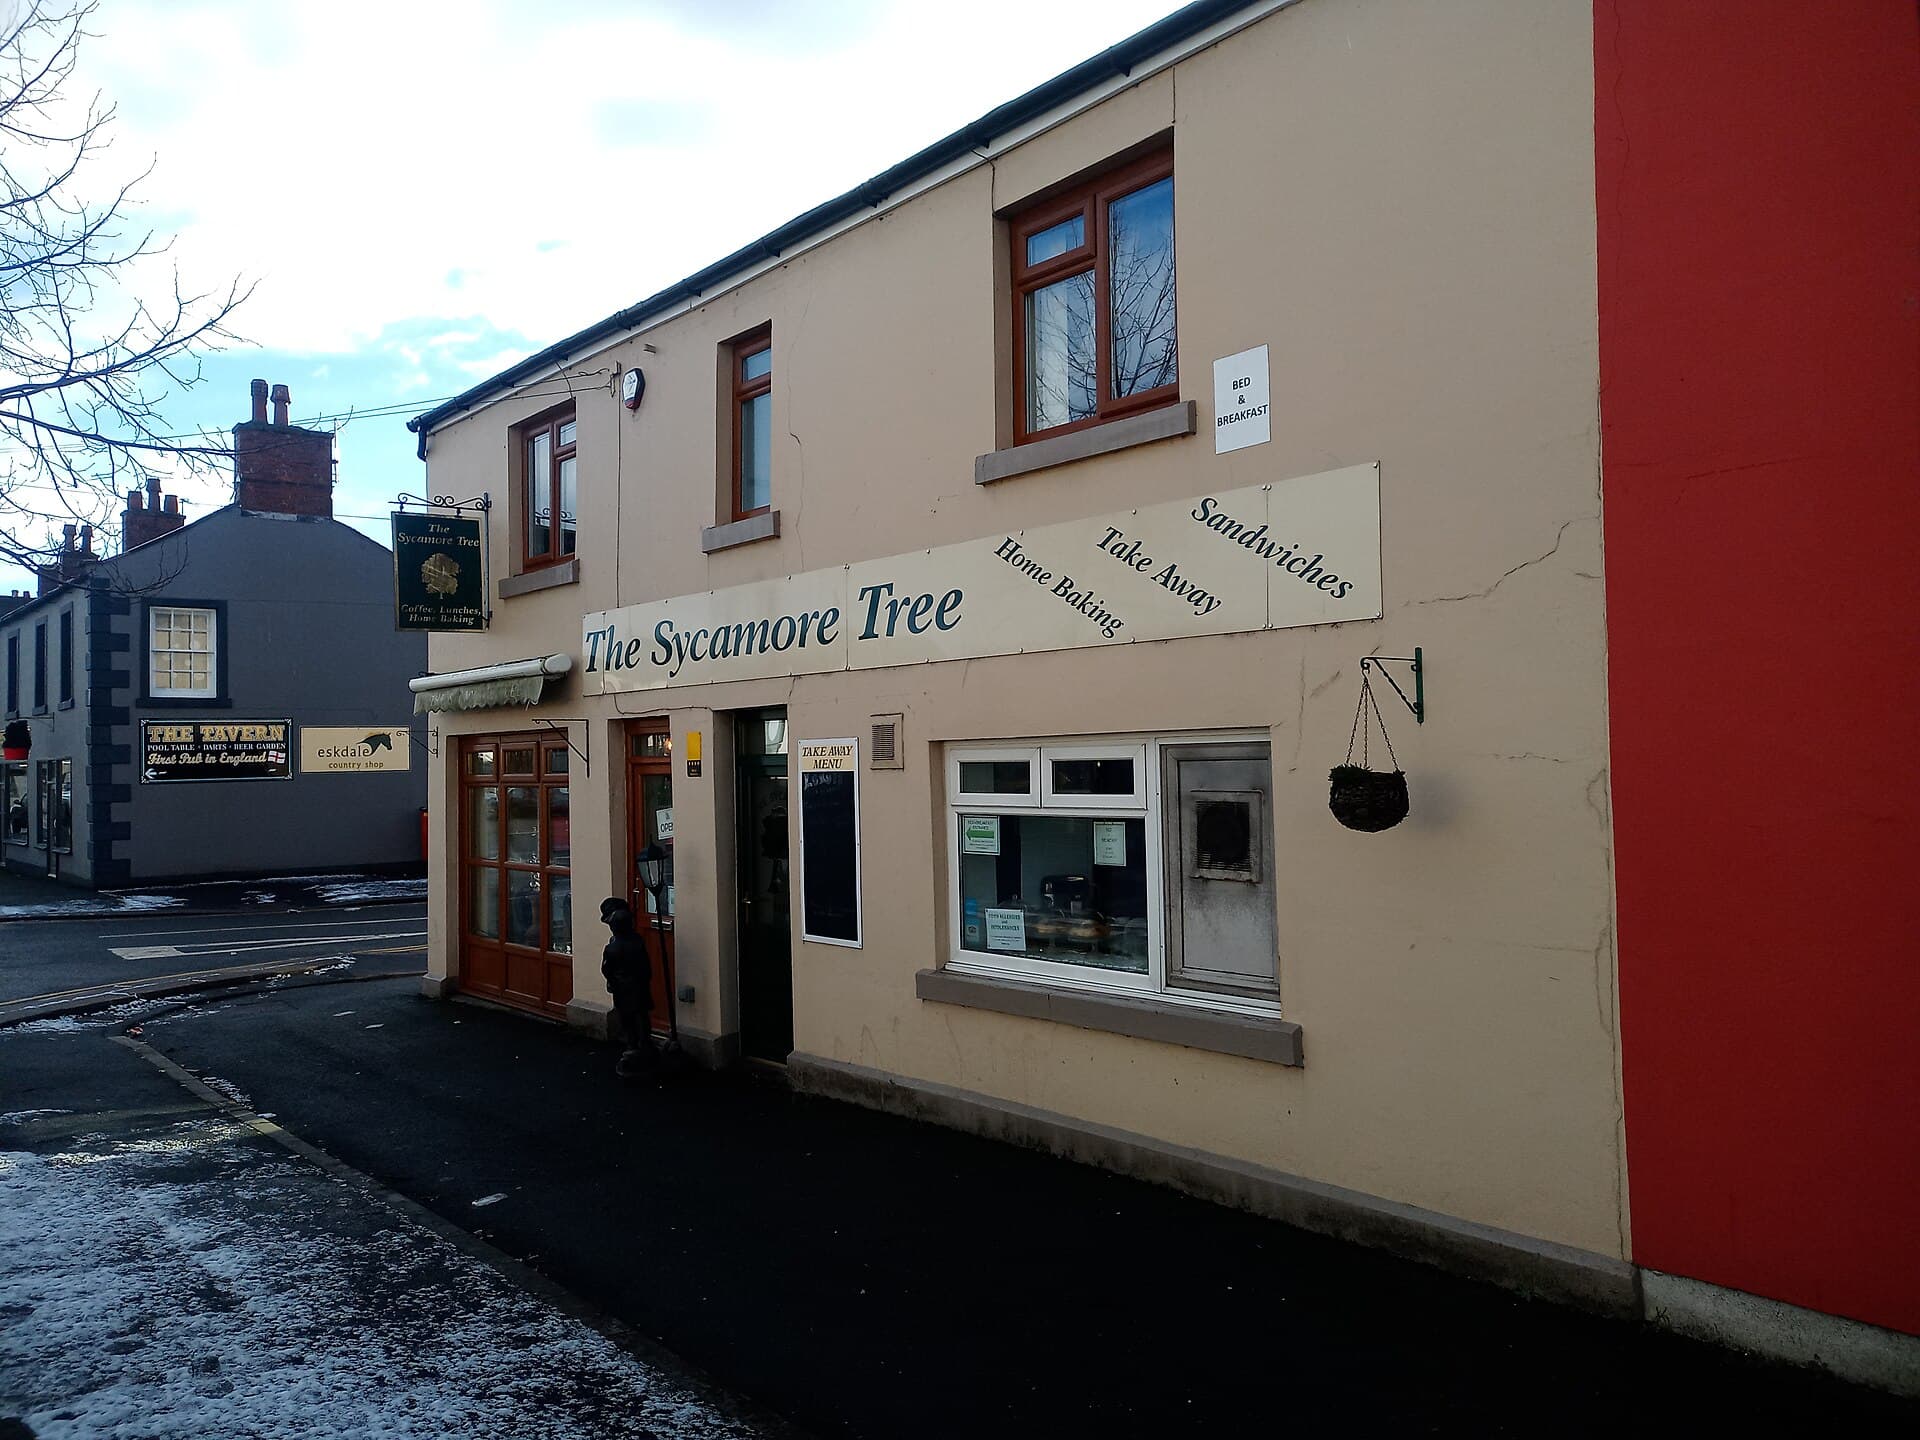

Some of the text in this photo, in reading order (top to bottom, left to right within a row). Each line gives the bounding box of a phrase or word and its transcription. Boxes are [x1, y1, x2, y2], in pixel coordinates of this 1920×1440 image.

[1232, 377, 1251, 390] BED
[1237, 394, 1246, 405] &
[1216, 404, 1268, 427] BREAKFAST
[428, 523, 450, 534] The
[397, 532, 480, 547] Sycamore Tree
[1192, 497, 1354, 599] Sandwiches
[1097, 526, 1222, 617] Take Away
[994, 536, 1124, 639] Home Baking
[409, 613, 475, 626] Home Baking
[585, 582, 964, 677] The Sycamore Tree
[147, 724, 286, 743] THE TAVERN
[203, 743, 227, 751] DARTS
[256, 742, 286, 750] GARDEN
[317, 745, 370, 758] eskdale
[802, 745, 853, 757] TAKE AWAY
[147, 751, 267, 767] First Pub in England
[365, 761, 384, 769] shop
[813, 758, 843, 769] MENU
